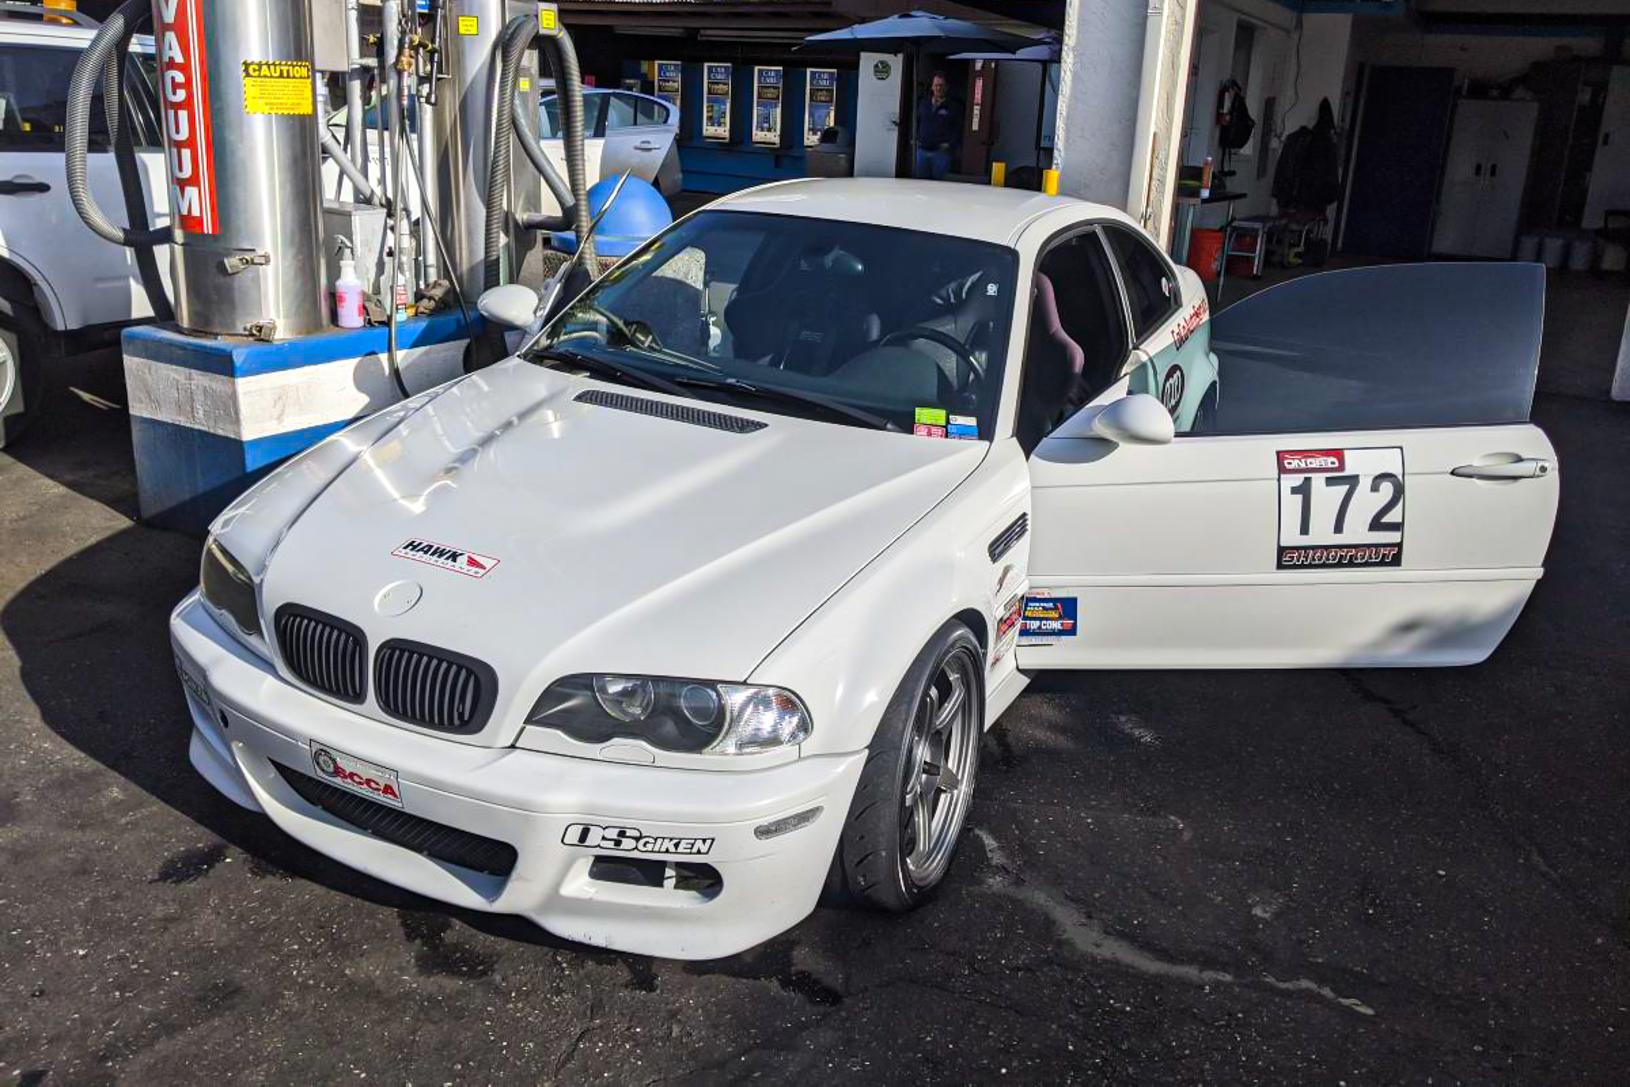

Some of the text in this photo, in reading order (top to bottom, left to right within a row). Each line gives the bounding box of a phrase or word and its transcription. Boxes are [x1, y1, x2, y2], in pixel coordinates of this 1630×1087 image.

[248, 64, 308, 78] CAUTION
[160, 0, 201, 216] VACUUM
[1290, 472, 1403, 536] 172
[403, 540, 464, 563] HAWK
[1281, 546, 1398, 565] SHOOTOUT
[1024, 620, 1040, 630] TOP
[333, 763, 399, 799] SCCA
[636, 836, 716, 855] GIKEN
